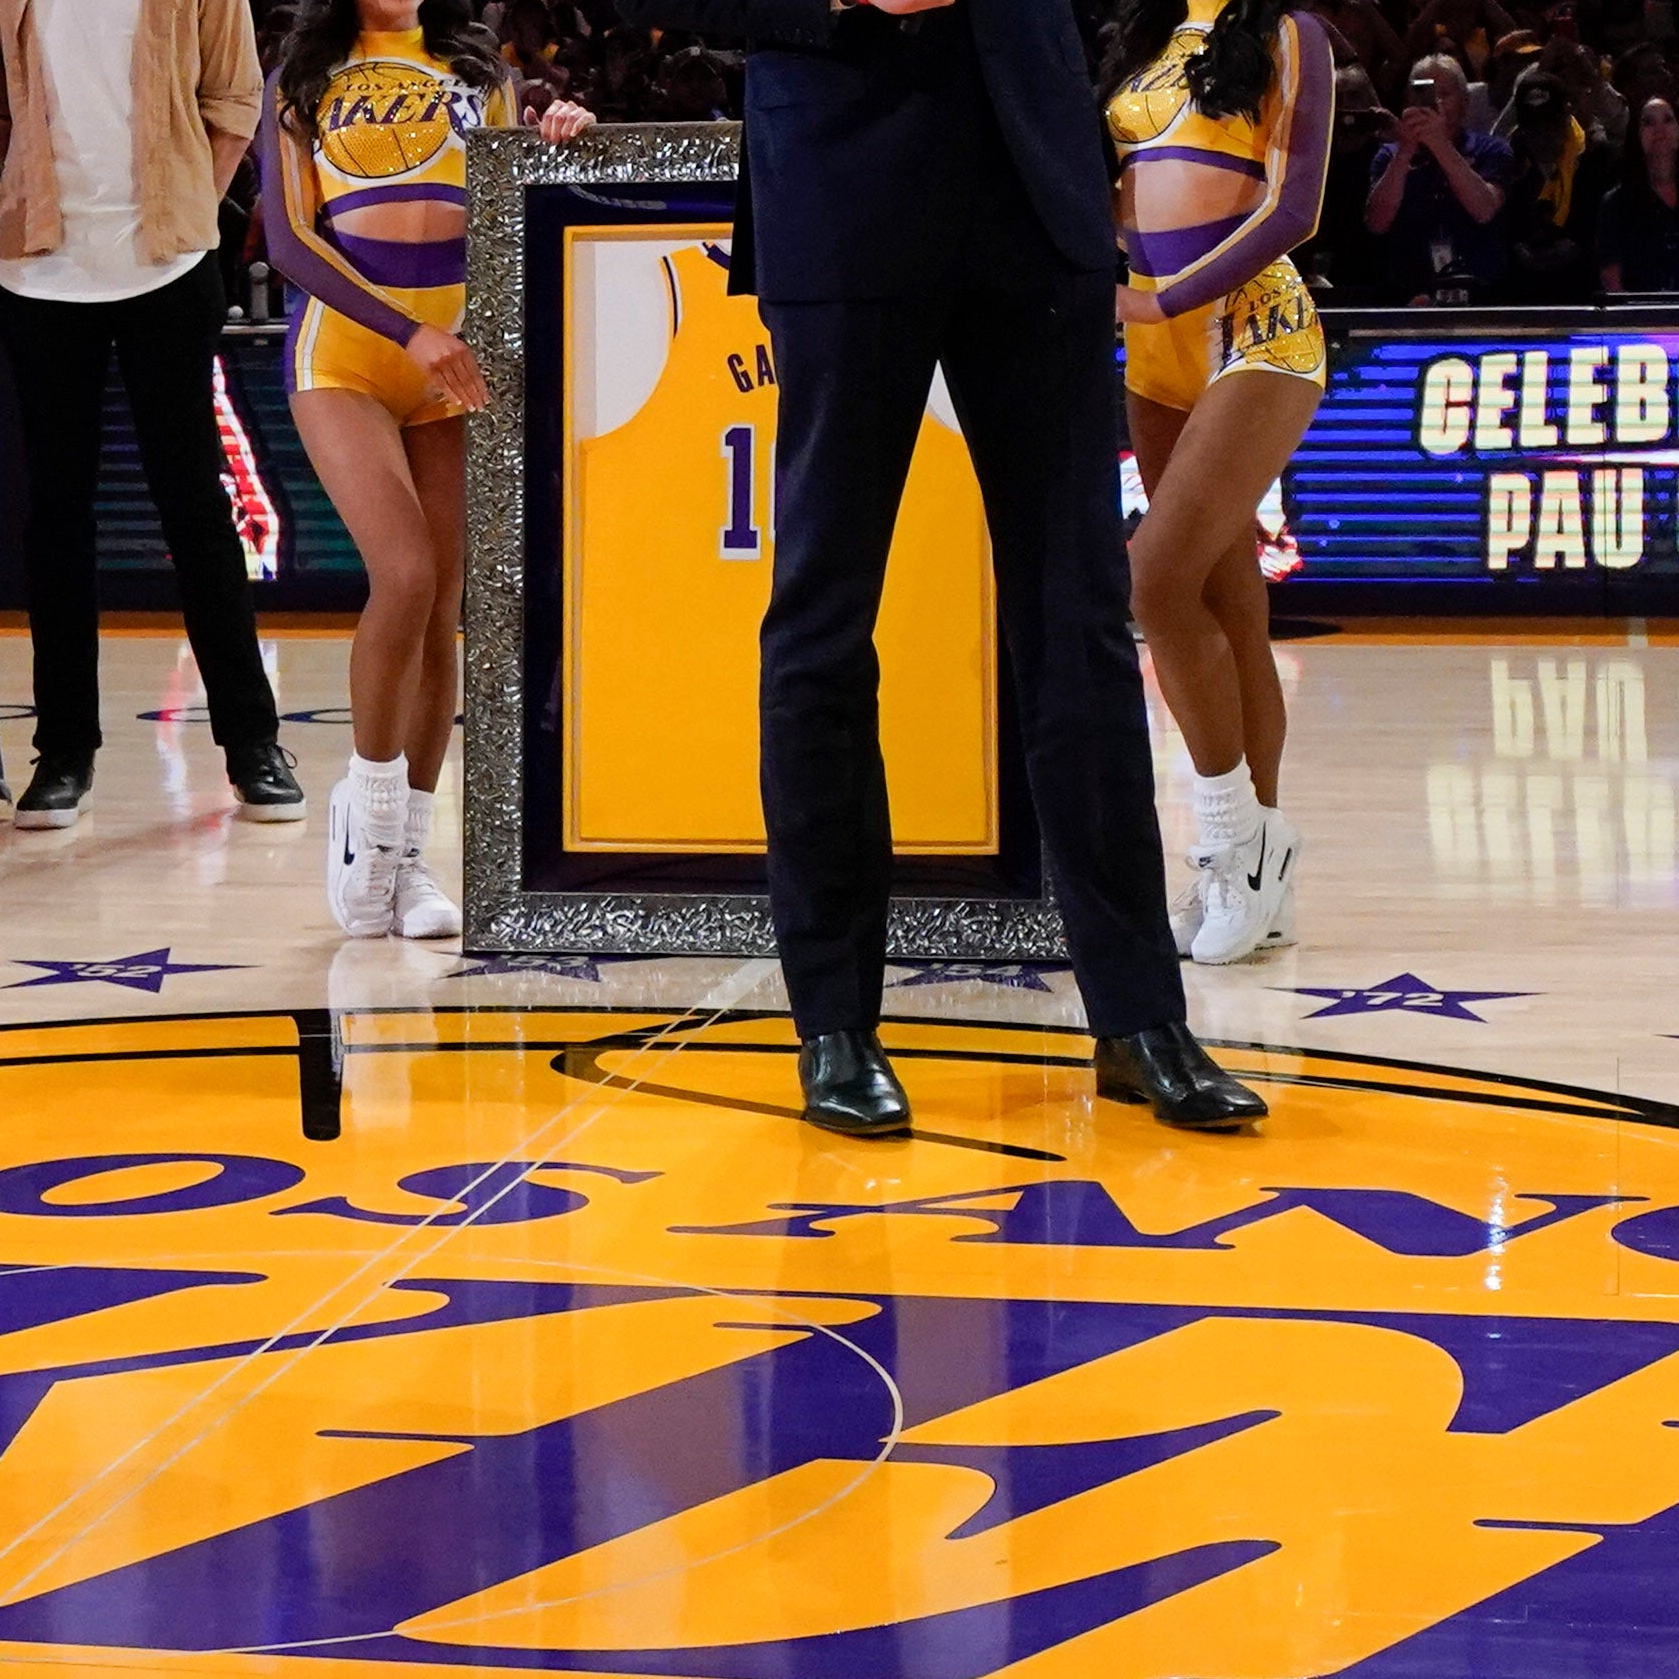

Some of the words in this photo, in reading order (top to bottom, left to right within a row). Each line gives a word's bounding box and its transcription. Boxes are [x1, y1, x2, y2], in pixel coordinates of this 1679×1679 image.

[325, 90, 482, 141] AKERS
[719, 424, 776, 561] 1
[1487, 467, 1650, 571] PAU
